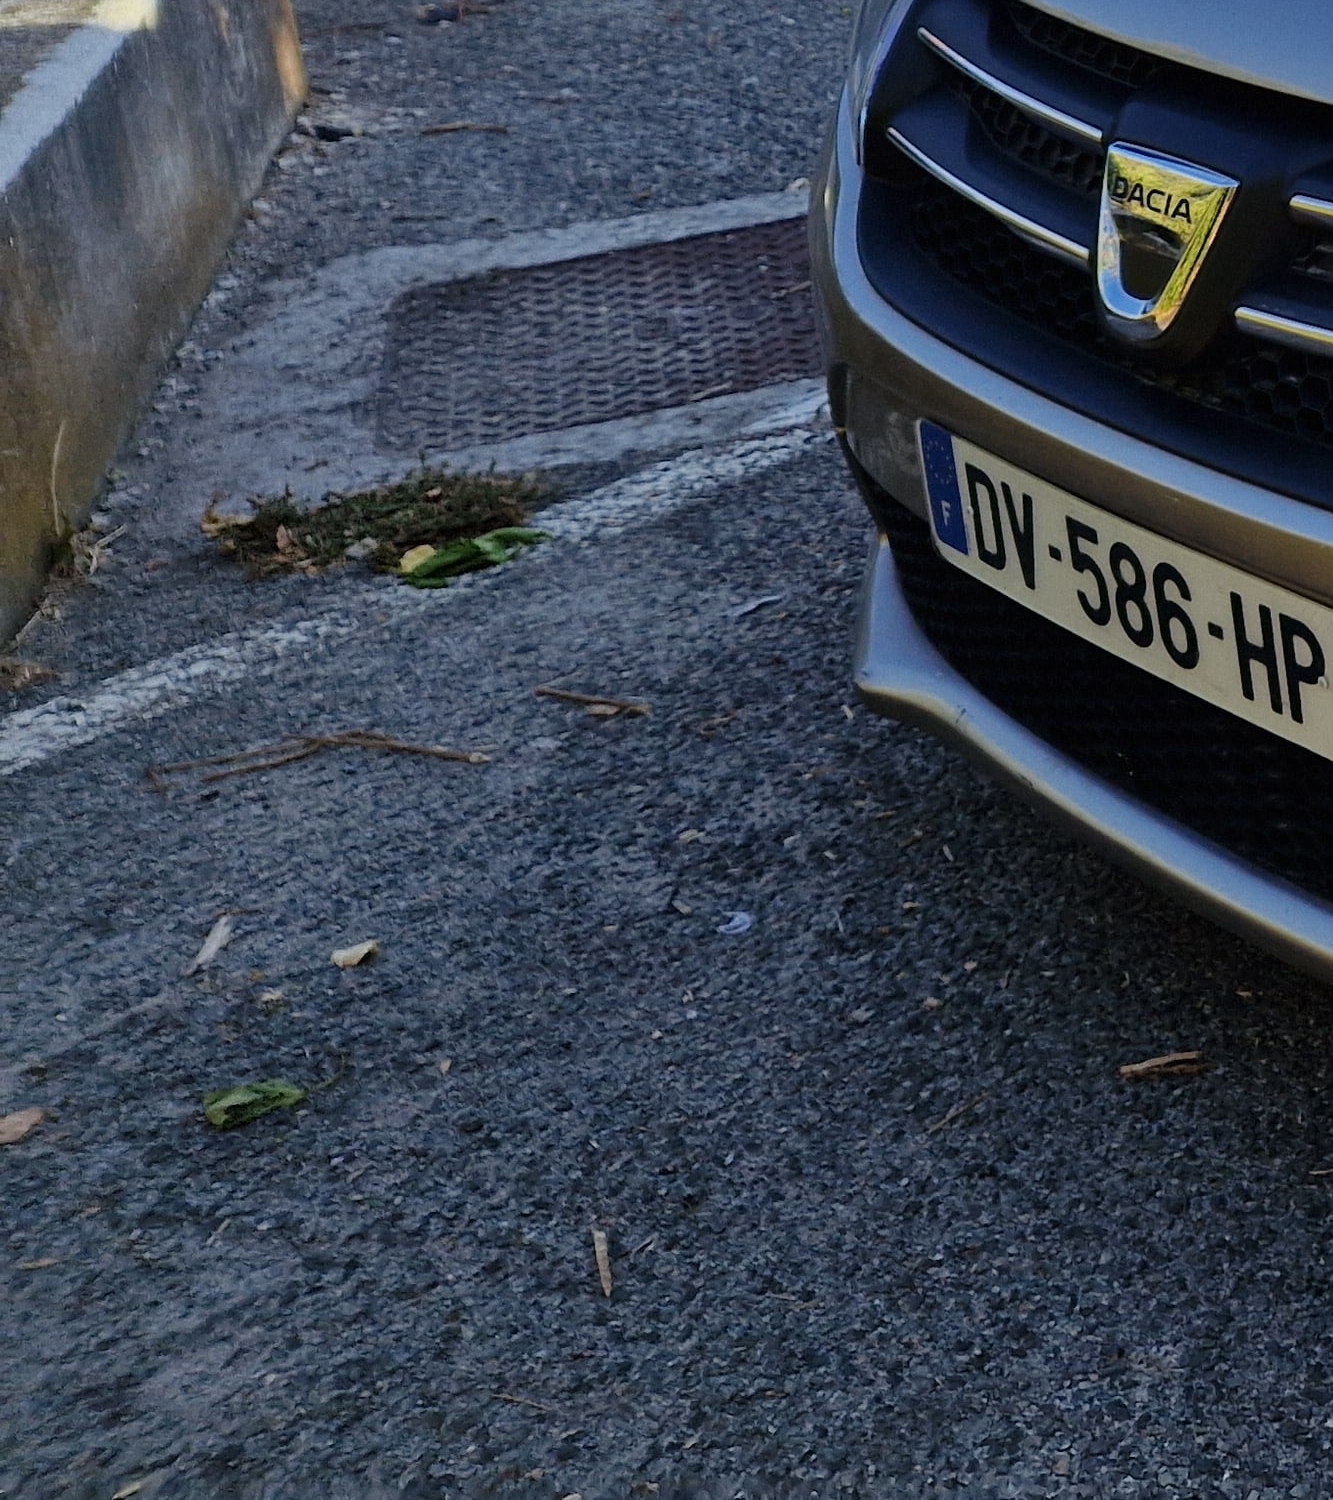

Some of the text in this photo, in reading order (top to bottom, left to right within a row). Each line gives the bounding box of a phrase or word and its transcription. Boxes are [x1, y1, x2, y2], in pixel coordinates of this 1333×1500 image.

[1111, 175, 1192, 224] DACIA
[940, 499, 952, 527] F
[965, 462, 1326, 724] DV-586-HP
